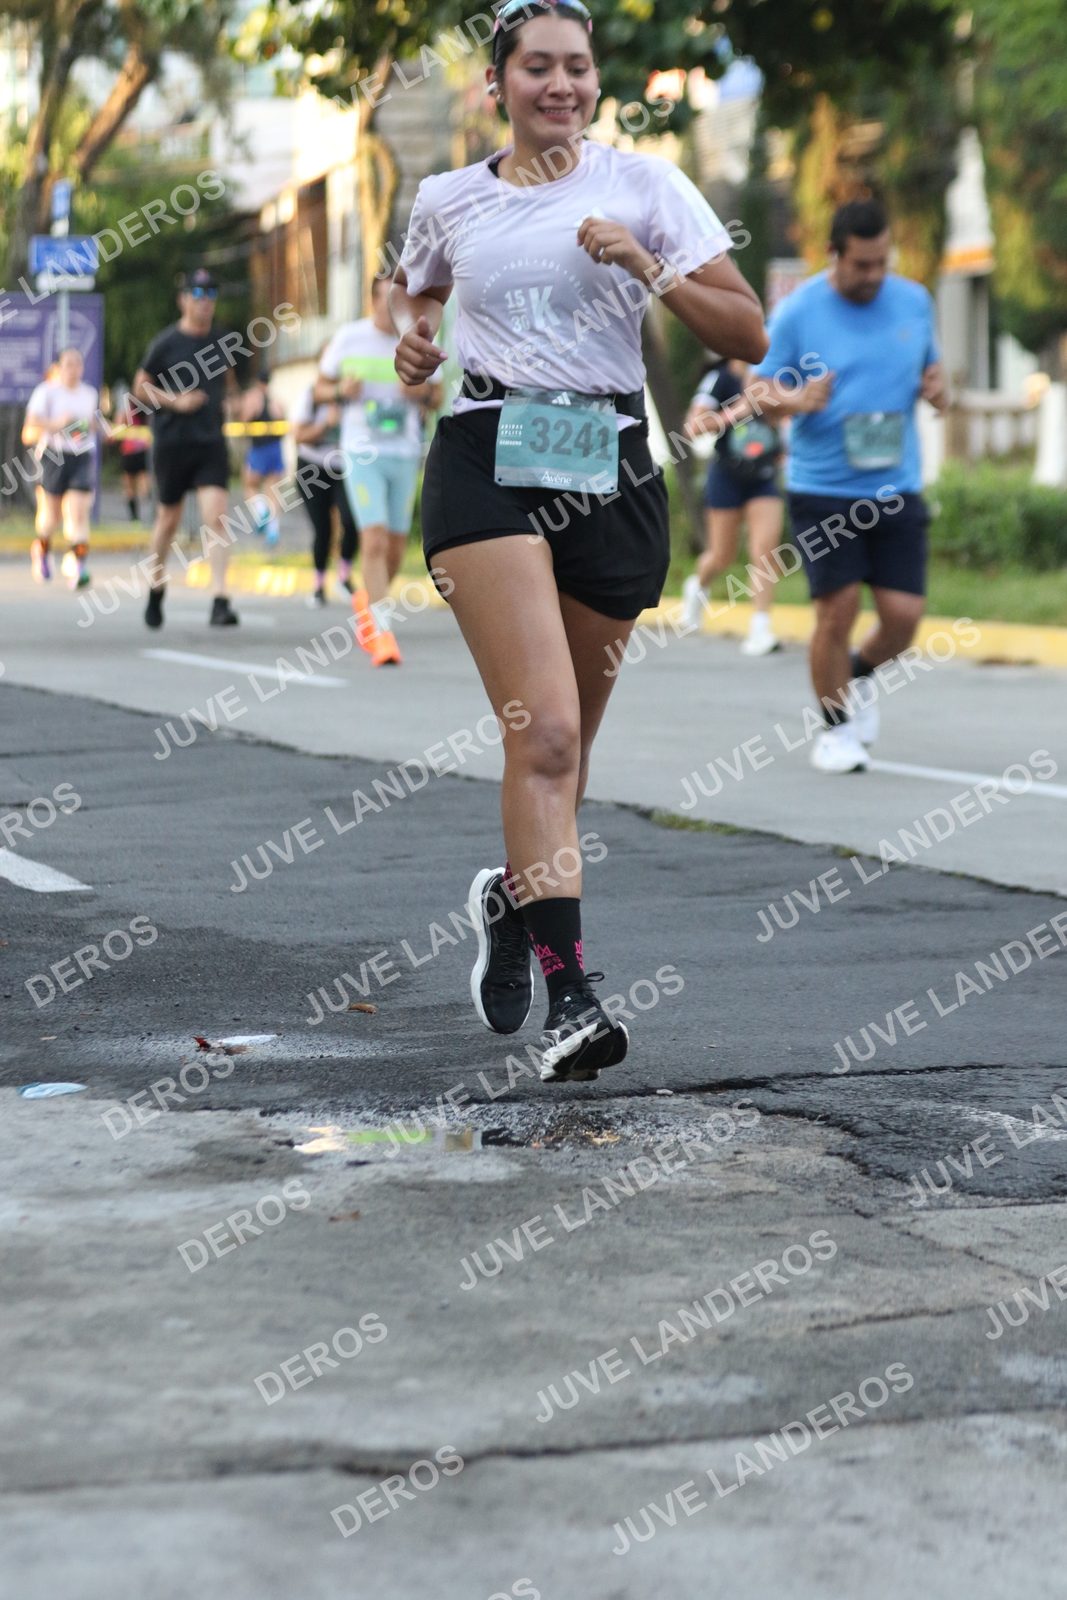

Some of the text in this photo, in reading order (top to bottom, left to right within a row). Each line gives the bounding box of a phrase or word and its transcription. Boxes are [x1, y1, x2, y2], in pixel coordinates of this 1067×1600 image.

[504, 285, 561, 330] 15 K
[529, 416, 613, 462] 3241
